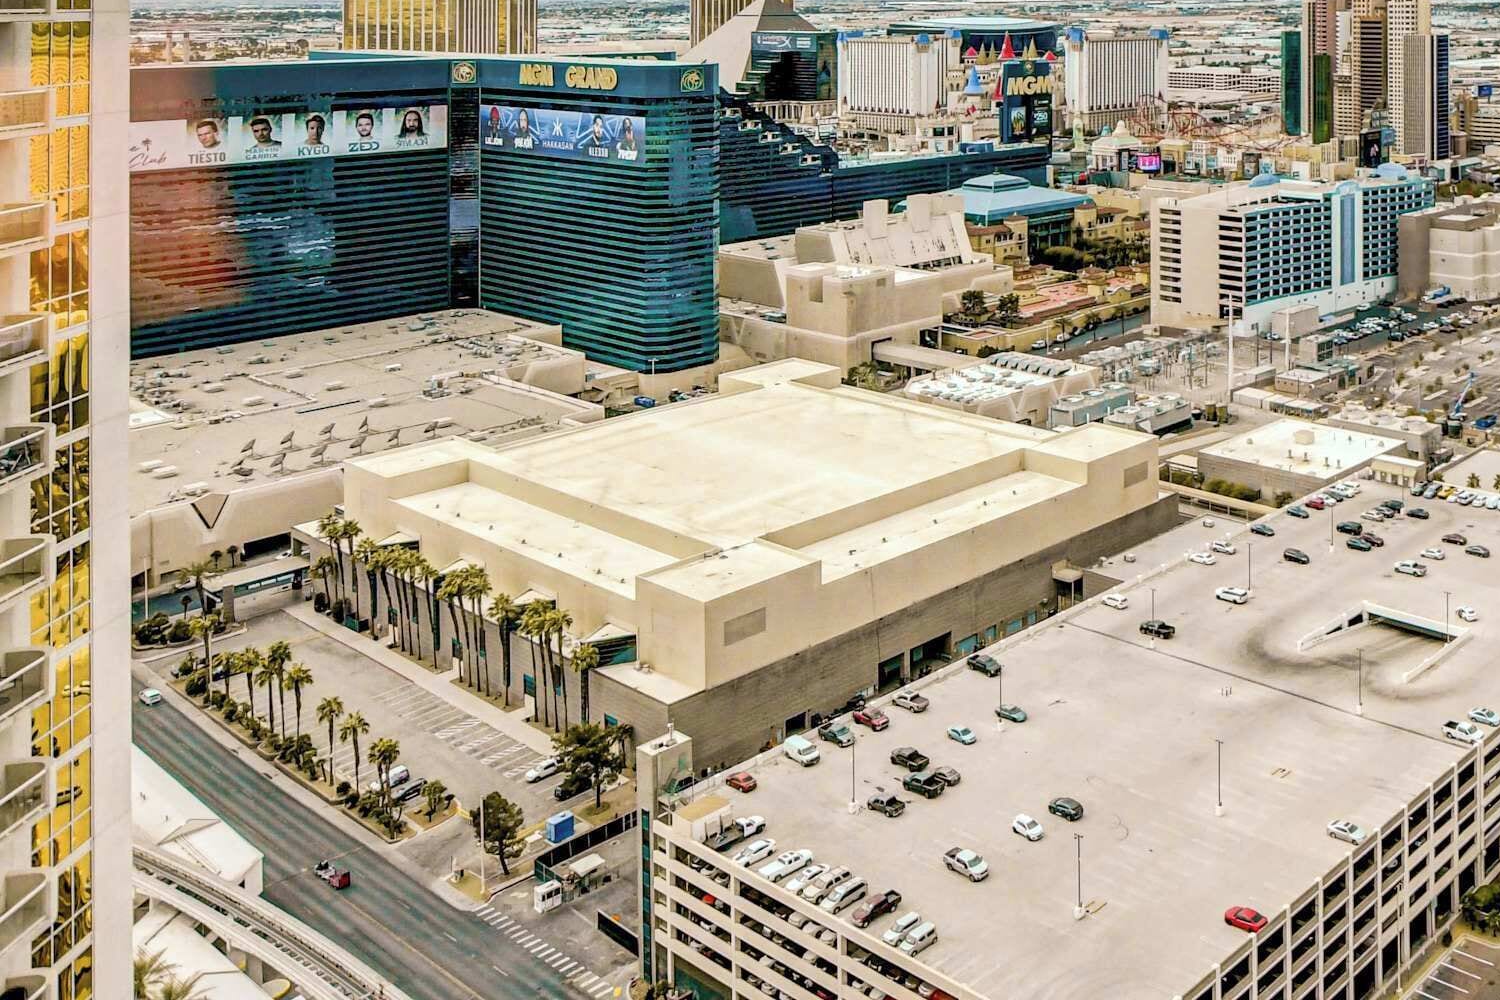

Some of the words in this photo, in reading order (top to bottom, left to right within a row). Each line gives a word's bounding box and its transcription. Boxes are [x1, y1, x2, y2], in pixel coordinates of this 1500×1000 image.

[519, 63, 554, 87] MGM
[565, 65, 618, 90] GRAND
[1007, 76, 1052, 96] MGM
[298, 145, 330, 156] KYGO
